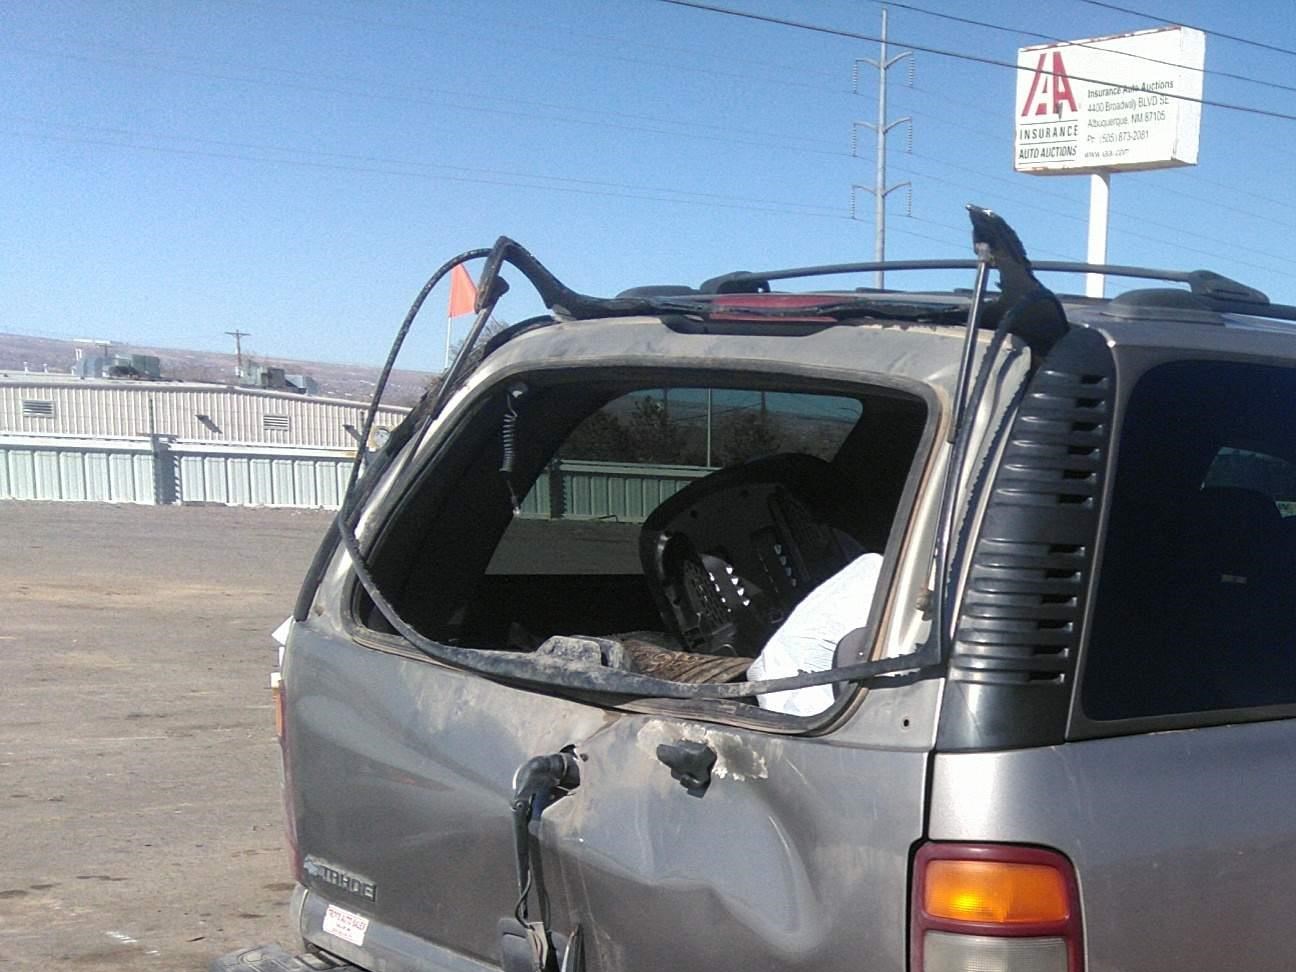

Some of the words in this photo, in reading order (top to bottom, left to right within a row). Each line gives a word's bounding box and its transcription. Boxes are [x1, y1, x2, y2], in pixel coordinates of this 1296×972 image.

[1087, 87, 1121, 98] Insurance
[1141, 80, 1174, 91] Auctions
[1138, 95, 1158, 108] BLVD
[1019, 125, 1079, 141] INSURANCE
[1018, 147, 1040, 160] AUTO
[1041, 145, 1078, 158] AUCTIONS
